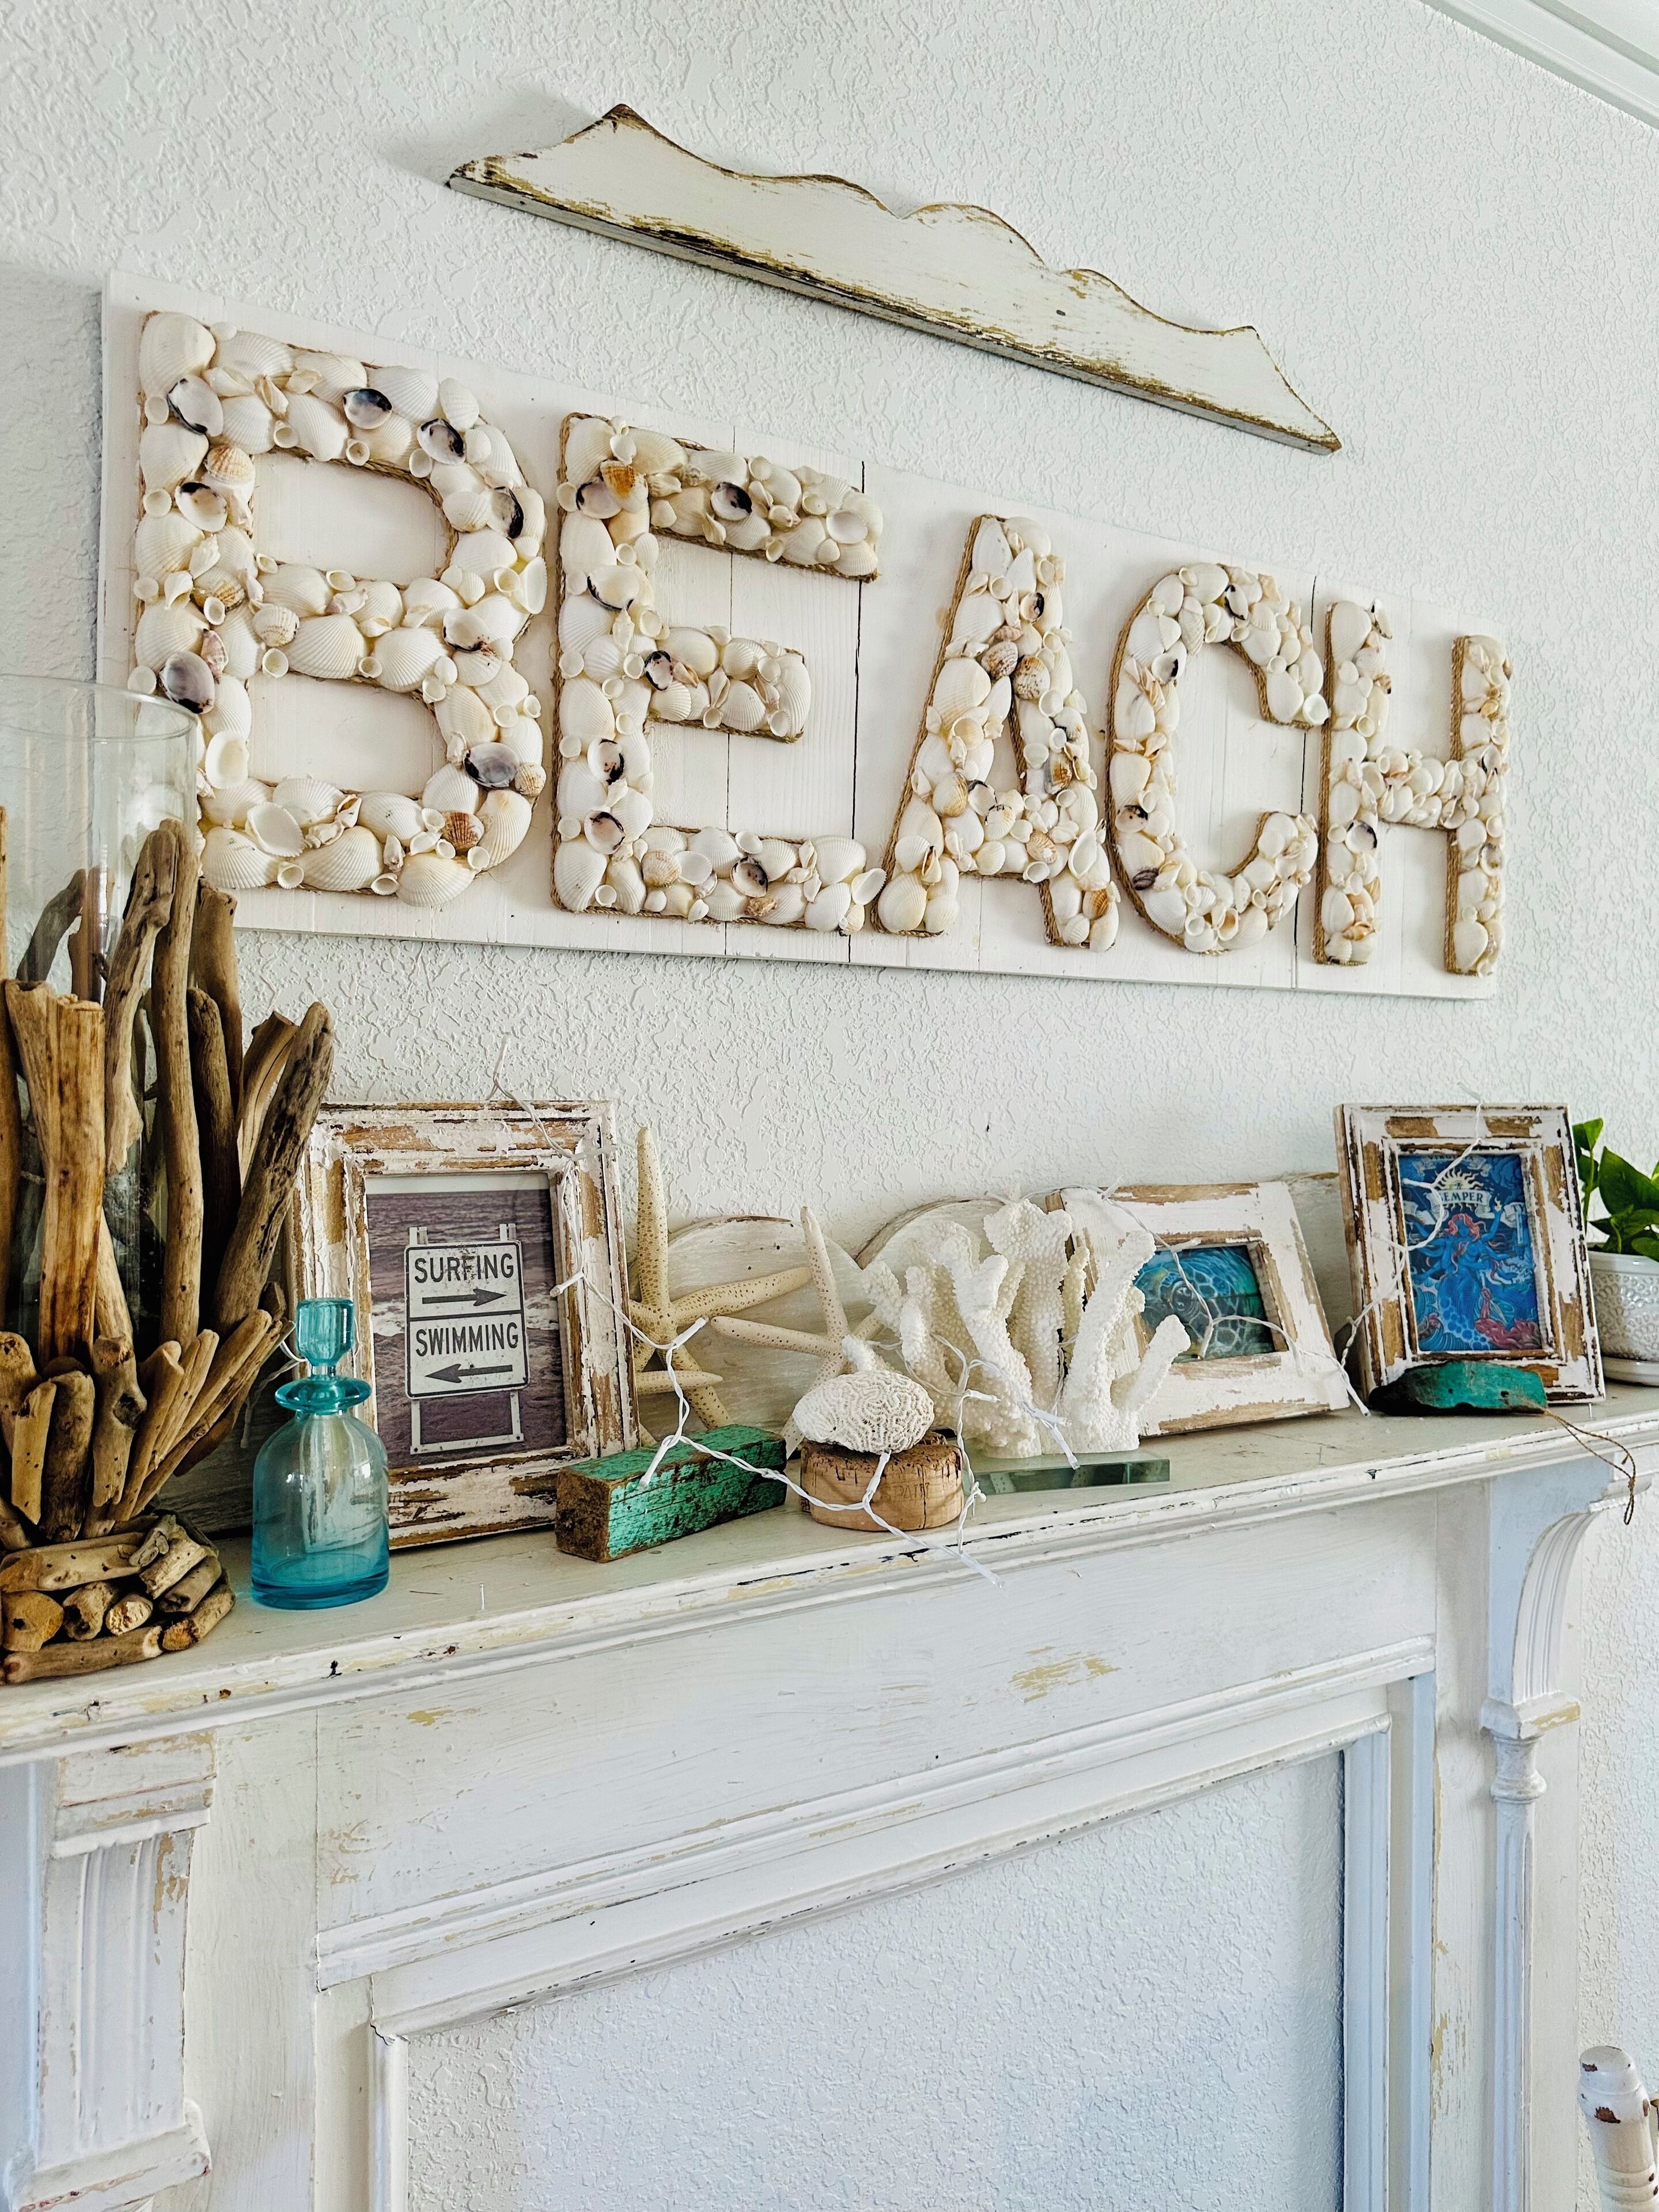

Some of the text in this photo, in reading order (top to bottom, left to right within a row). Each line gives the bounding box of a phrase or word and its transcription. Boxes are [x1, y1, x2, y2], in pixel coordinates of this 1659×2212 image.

[134, 310, 1513, 976] BEACH
[414, 1253, 514, 1283] SURFING
[415, 1322, 518, 1357] SWIMMING
